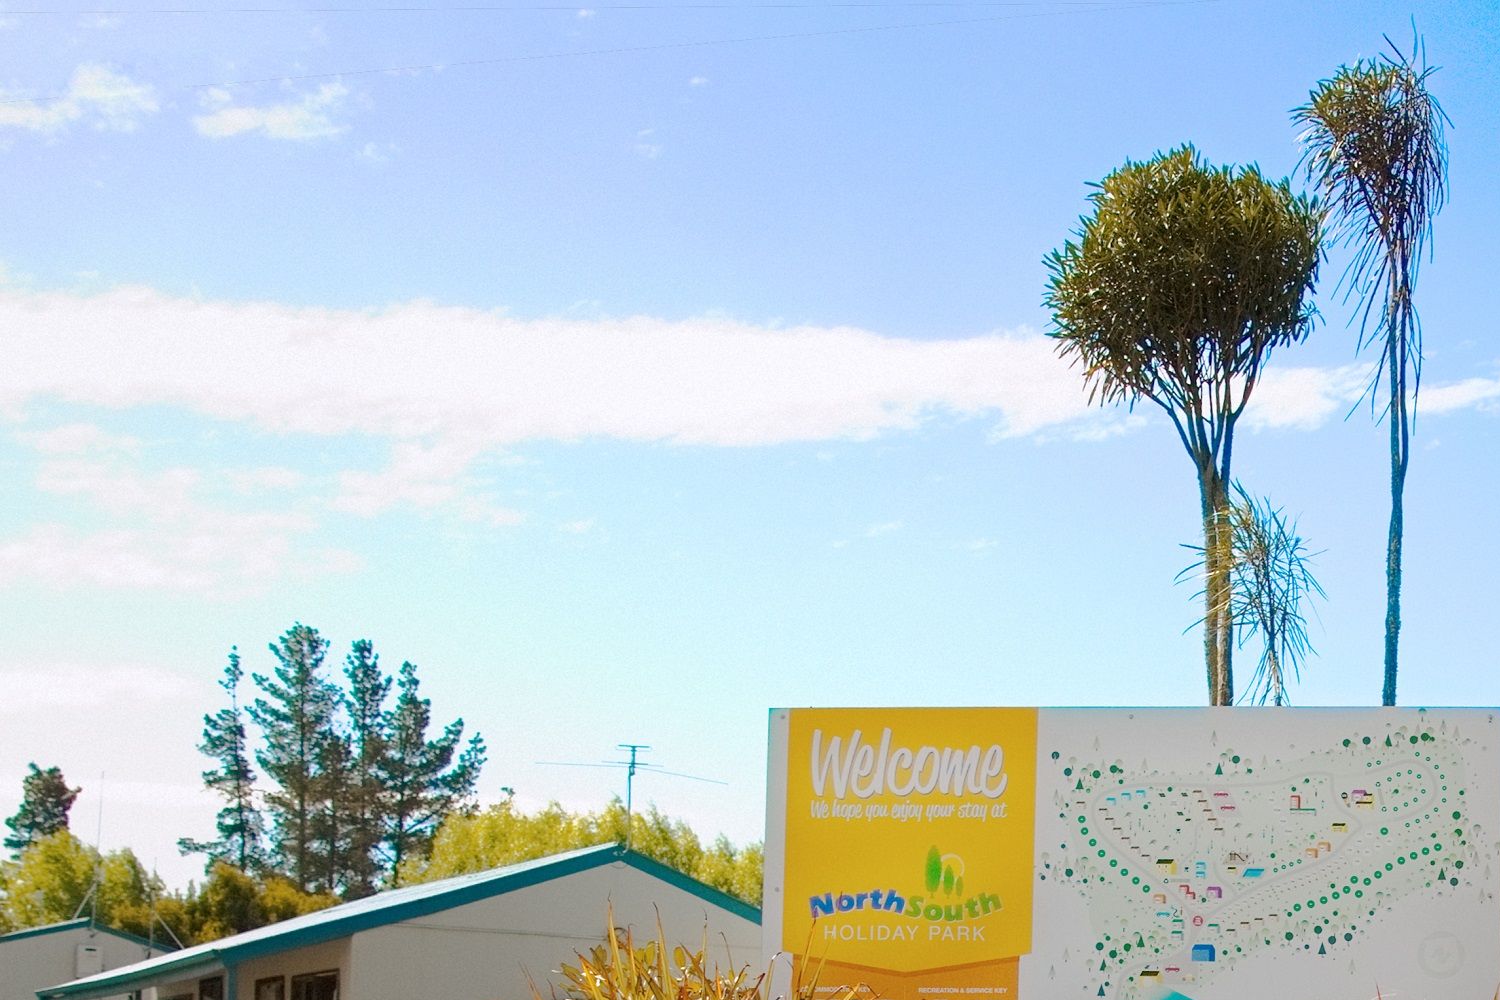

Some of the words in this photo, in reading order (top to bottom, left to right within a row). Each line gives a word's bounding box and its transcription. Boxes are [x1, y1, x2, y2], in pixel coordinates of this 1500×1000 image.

[811, 727, 1008, 799] Welcome
[811, 800, 829, 818] We
[832, 800, 864, 820] hope
[865, 804, 888, 820] you
[891, 801, 923, 821] enjoy
[926, 804, 954, 821] your
[958, 802, 987, 821] stay
[991, 802, 1008, 818] at
[824, 924, 920, 941] HOLIDAY
[929, 925, 986, 942] PARK
